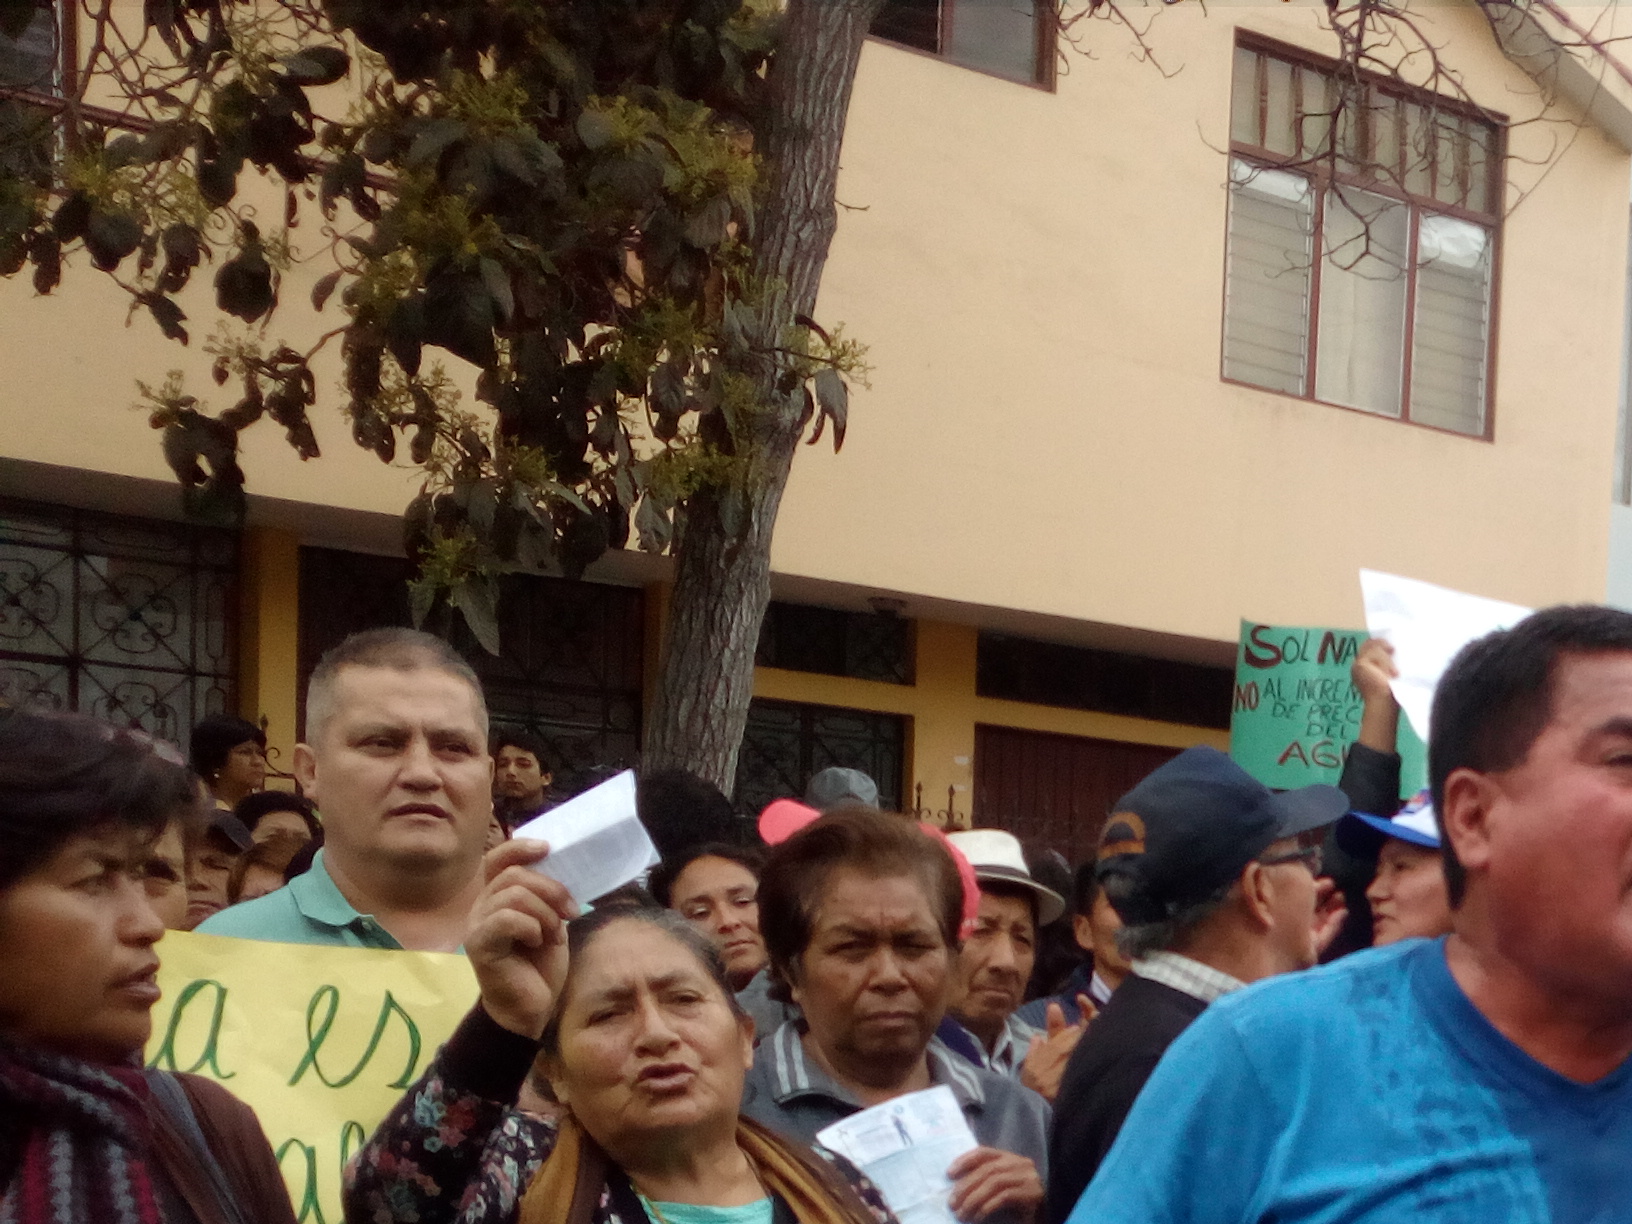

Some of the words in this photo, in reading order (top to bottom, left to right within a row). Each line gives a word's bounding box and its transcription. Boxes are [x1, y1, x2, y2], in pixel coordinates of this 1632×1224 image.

[1234, 680, 1260, 713] NO
[1263, 677, 1286, 701] AL
[1271, 702, 1300, 721] DE
[1306, 722, 1348, 740] DEL
